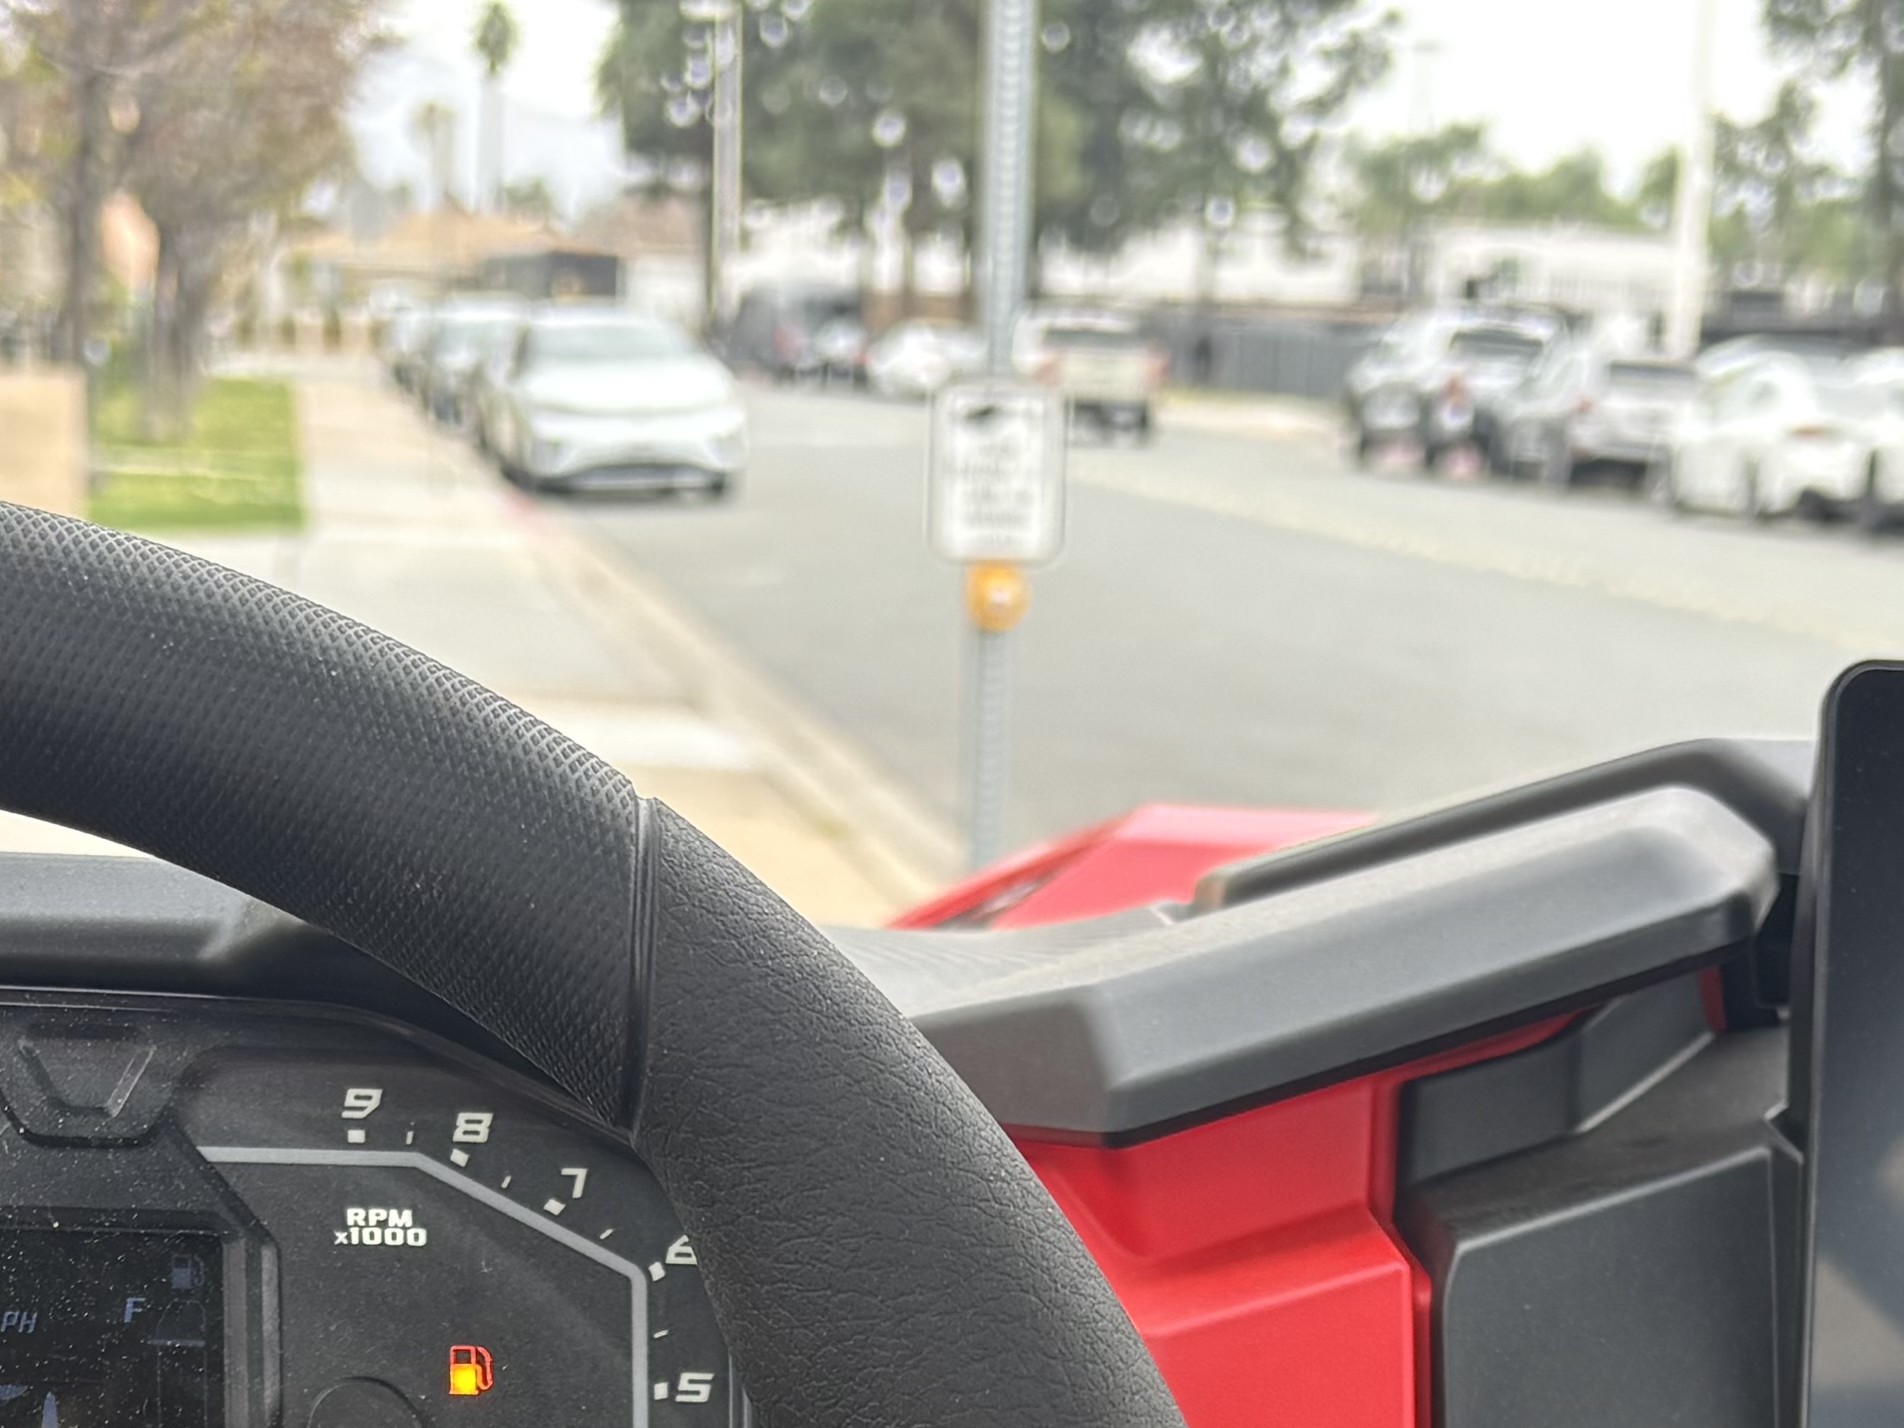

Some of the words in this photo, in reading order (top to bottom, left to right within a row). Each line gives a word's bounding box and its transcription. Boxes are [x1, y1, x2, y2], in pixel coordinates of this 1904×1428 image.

[341, 1088, 383, 1118] 9
[453, 1113, 493, 1142] 8
[561, 1168, 590, 1198] 7
[345, 1208, 414, 1229] RPM
[334, 1227, 428, 1247] x1000
[123, 1297, 146, 1323] F
[675, 1373, 715, 1403] 5
